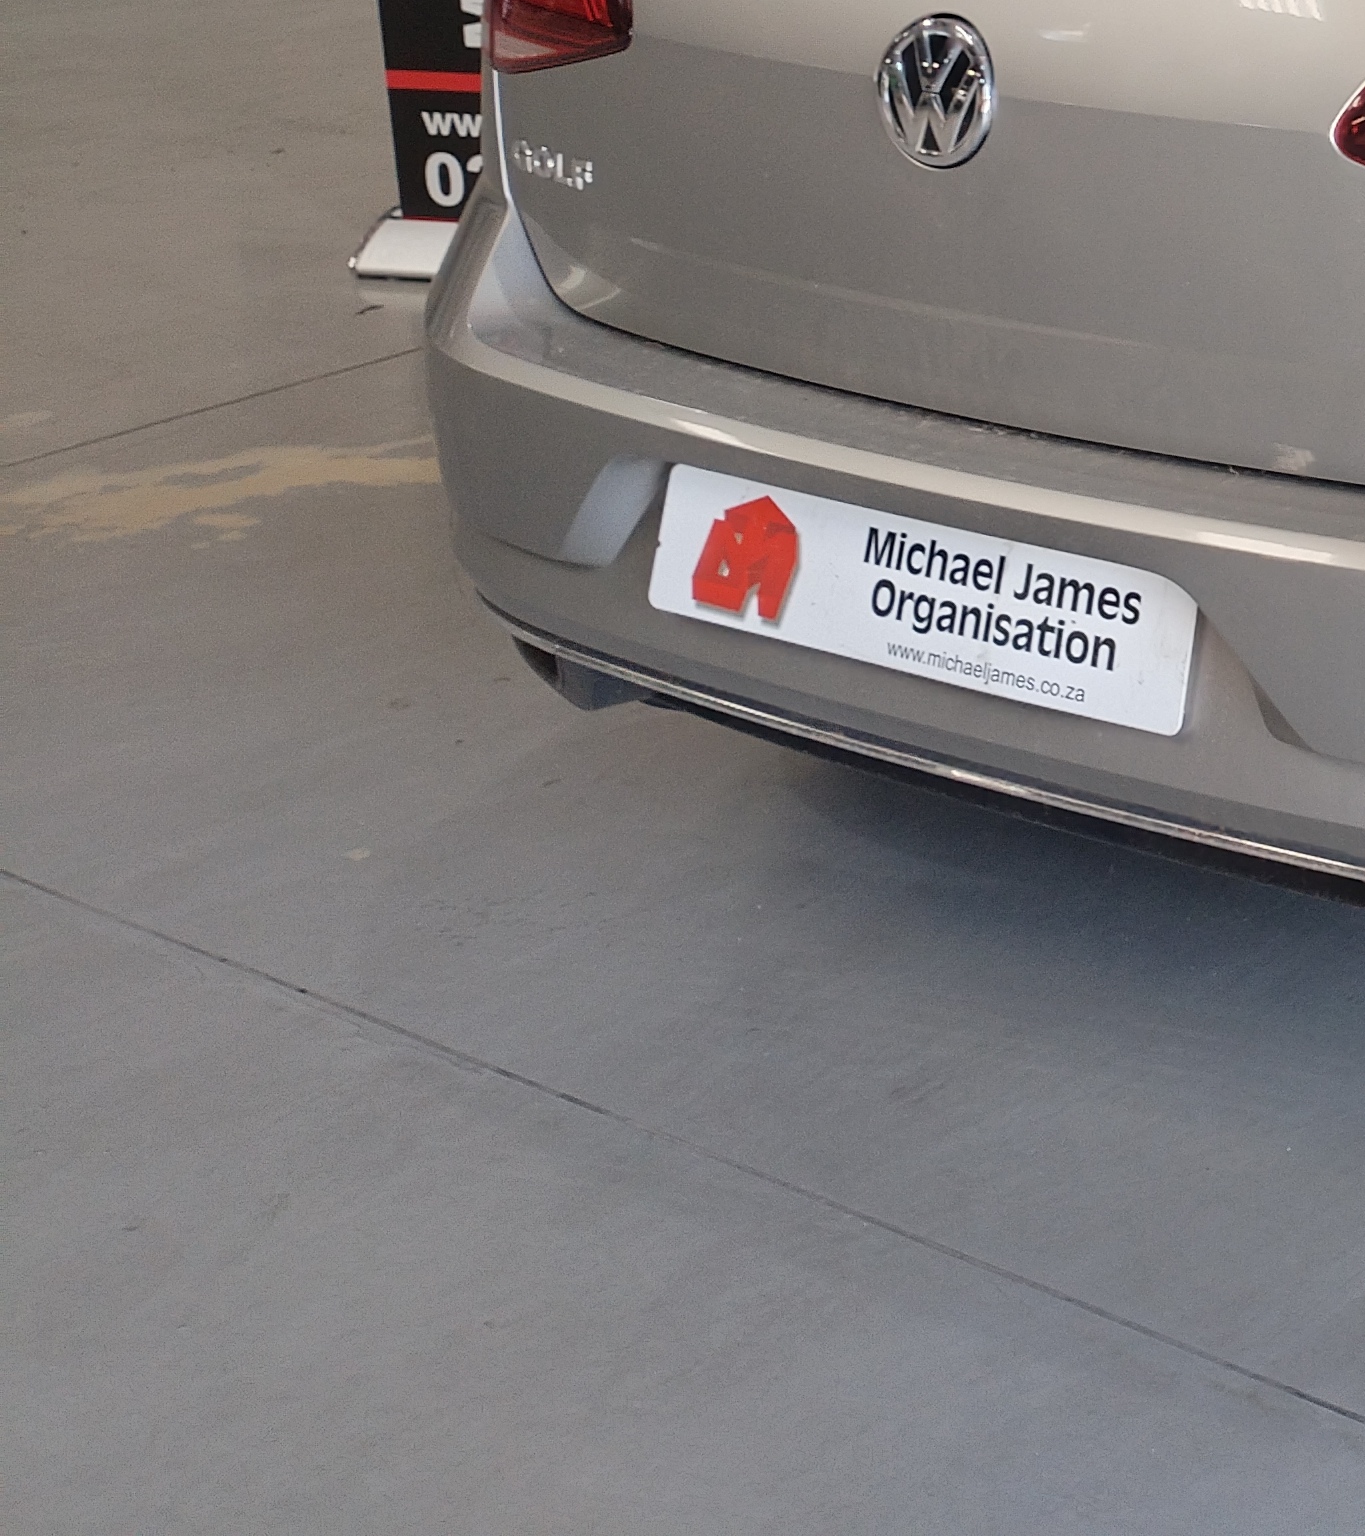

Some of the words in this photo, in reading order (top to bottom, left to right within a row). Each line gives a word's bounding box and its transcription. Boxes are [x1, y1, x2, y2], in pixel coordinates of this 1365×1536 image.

[512, 139, 594, 191] GOLF
[863, 526, 1006, 595] Michael
[1013, 563, 1142, 625] James
[871, 579, 1117, 672] Organisation
[886, 641, 1086, 703] www.michaeljames.co.za
